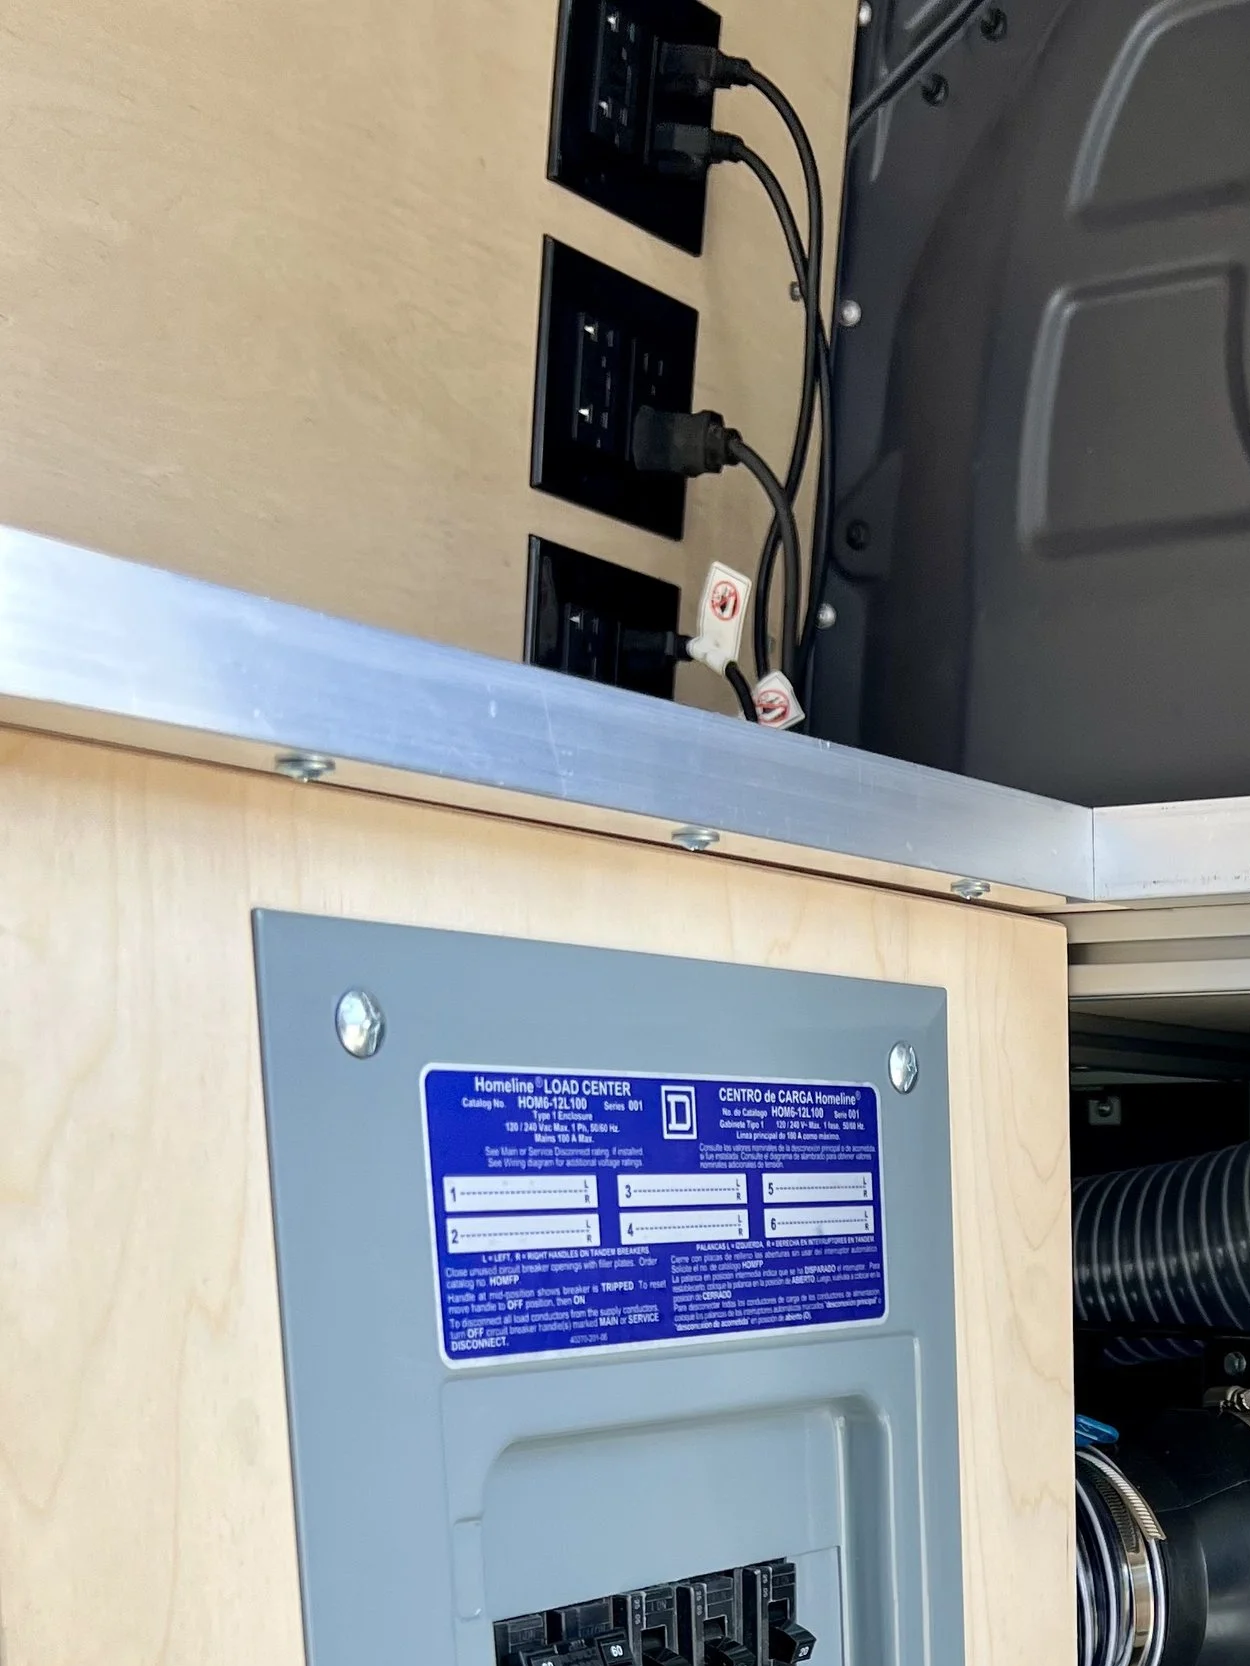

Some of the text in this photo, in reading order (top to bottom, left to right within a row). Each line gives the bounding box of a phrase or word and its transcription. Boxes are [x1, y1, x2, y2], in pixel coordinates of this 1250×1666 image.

[544, 1079, 579, 1095] LOAD
[582, 1080, 630, 1096] CENTER
[719, 1088, 762, 1101] CENTRO
[765, 1089, 776, 1103] de
[778, 1090, 813, 1104] CARGA
[462, 1097, 492, 1110] Catalog
[518, 1096, 587, 1110] HOM6-12L100
[604, 1101, 625, 1111] Series
[629, 1101, 643, 1111] 001
[533, 1111, 550, 1121] Type
[558, 1112, 593, 1120] Enclosure
[771, 1106, 824, 1118] HOM6-12L100
[834, 1111, 847, 1119] Serie
[848, 1110, 859, 1119] 001
[524, 1123, 537, 1131] 240
[720, 1120, 745, 1128] Gabinete
[747, 1120, 759, 1129] Tipo
[535, 1135, 556, 1143] Mains
[450, 1187, 456, 1202] 1
[625, 1185, 632, 1199] 3
[768, 1183, 774, 1195] 5
[585, 1195, 590, 1203] R
[627, 1223, 634, 1236] 4
[771, 1217, 776, 1230] 6
[451, 1229, 459, 1243] 2
[586, 1234, 592, 1243] R
[738, 1228, 744, 1237] R
[527, 1252, 547, 1260] RIGHT
[549, 1251, 578, 1259] HANDLES
[580, 1250, 589, 1258] ON
[591, 1249, 616, 1257] TANDEM
[617, 1247, 649, 1256] BREAKERS
[602, 1282, 634, 1292] TRIPPED
[507, 1300, 523, 1310] OFF
[468, 1328, 484, 1338] OFF
[600, 1317, 618, 1327] MAIN
[628, 1313, 659, 1324] SERVICE
[610, 1645, 623, 1657] 60
[799, 1646, 809, 1656] 20
